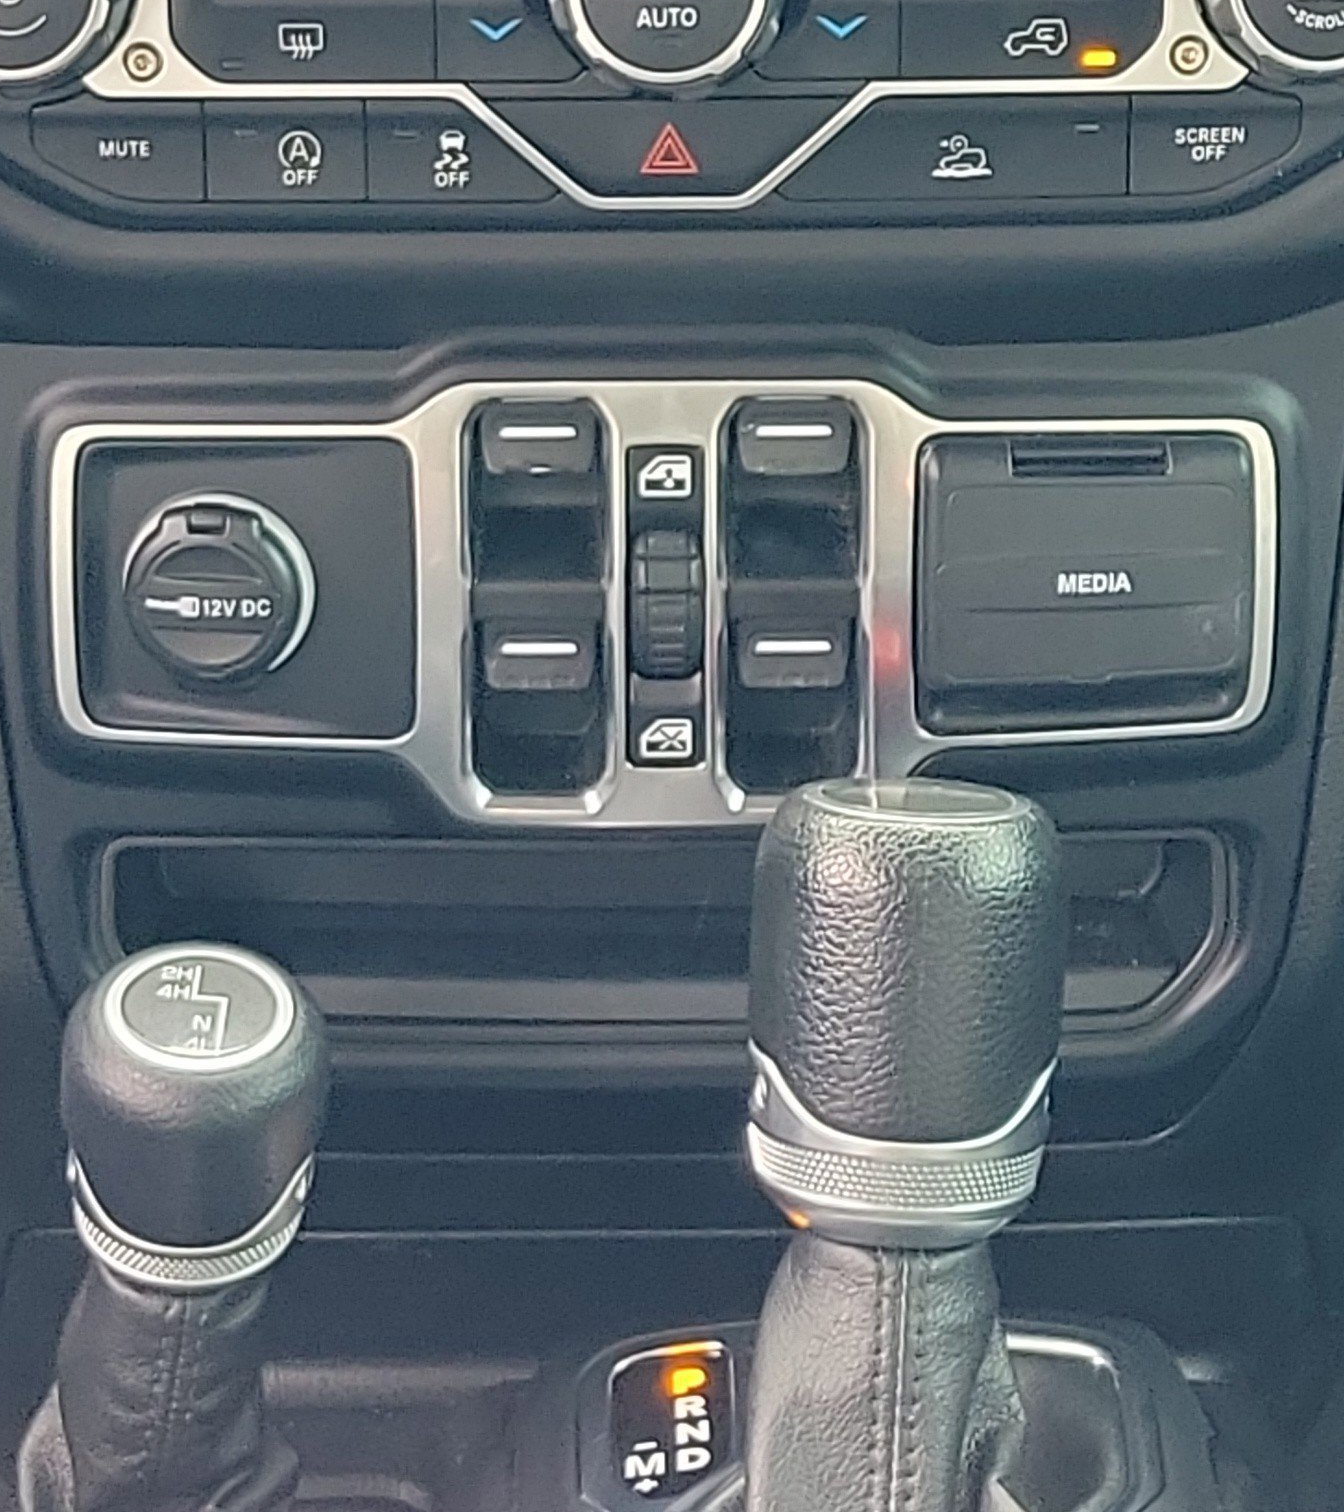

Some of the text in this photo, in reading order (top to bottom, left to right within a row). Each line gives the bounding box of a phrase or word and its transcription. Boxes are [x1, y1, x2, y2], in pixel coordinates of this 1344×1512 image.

[636, 7, 698, 29] AUTO
[1175, 128, 1245, 144] SCREEN
[99, 139, 150, 159] MUTE
[1191, 145, 1226, 161] OFF
[283, 170, 317, 187] OFF
[434, 171, 469, 188] OFF
[1057, 572, 1132, 594] MEDIA
[202, 599, 272, 617] 12V DC
[161, 965, 193, 980] 2H
[156, 983, 191, 999] 4H
[192, 1014, 212, 1032] N
[671, 1369, 706, 1394] P
[674, 1396, 707, 1419] R
[676, 1420, 710, 1445] N
[624, 1452, 666, 1479] M
[676, 1448, 711, 1472] D
